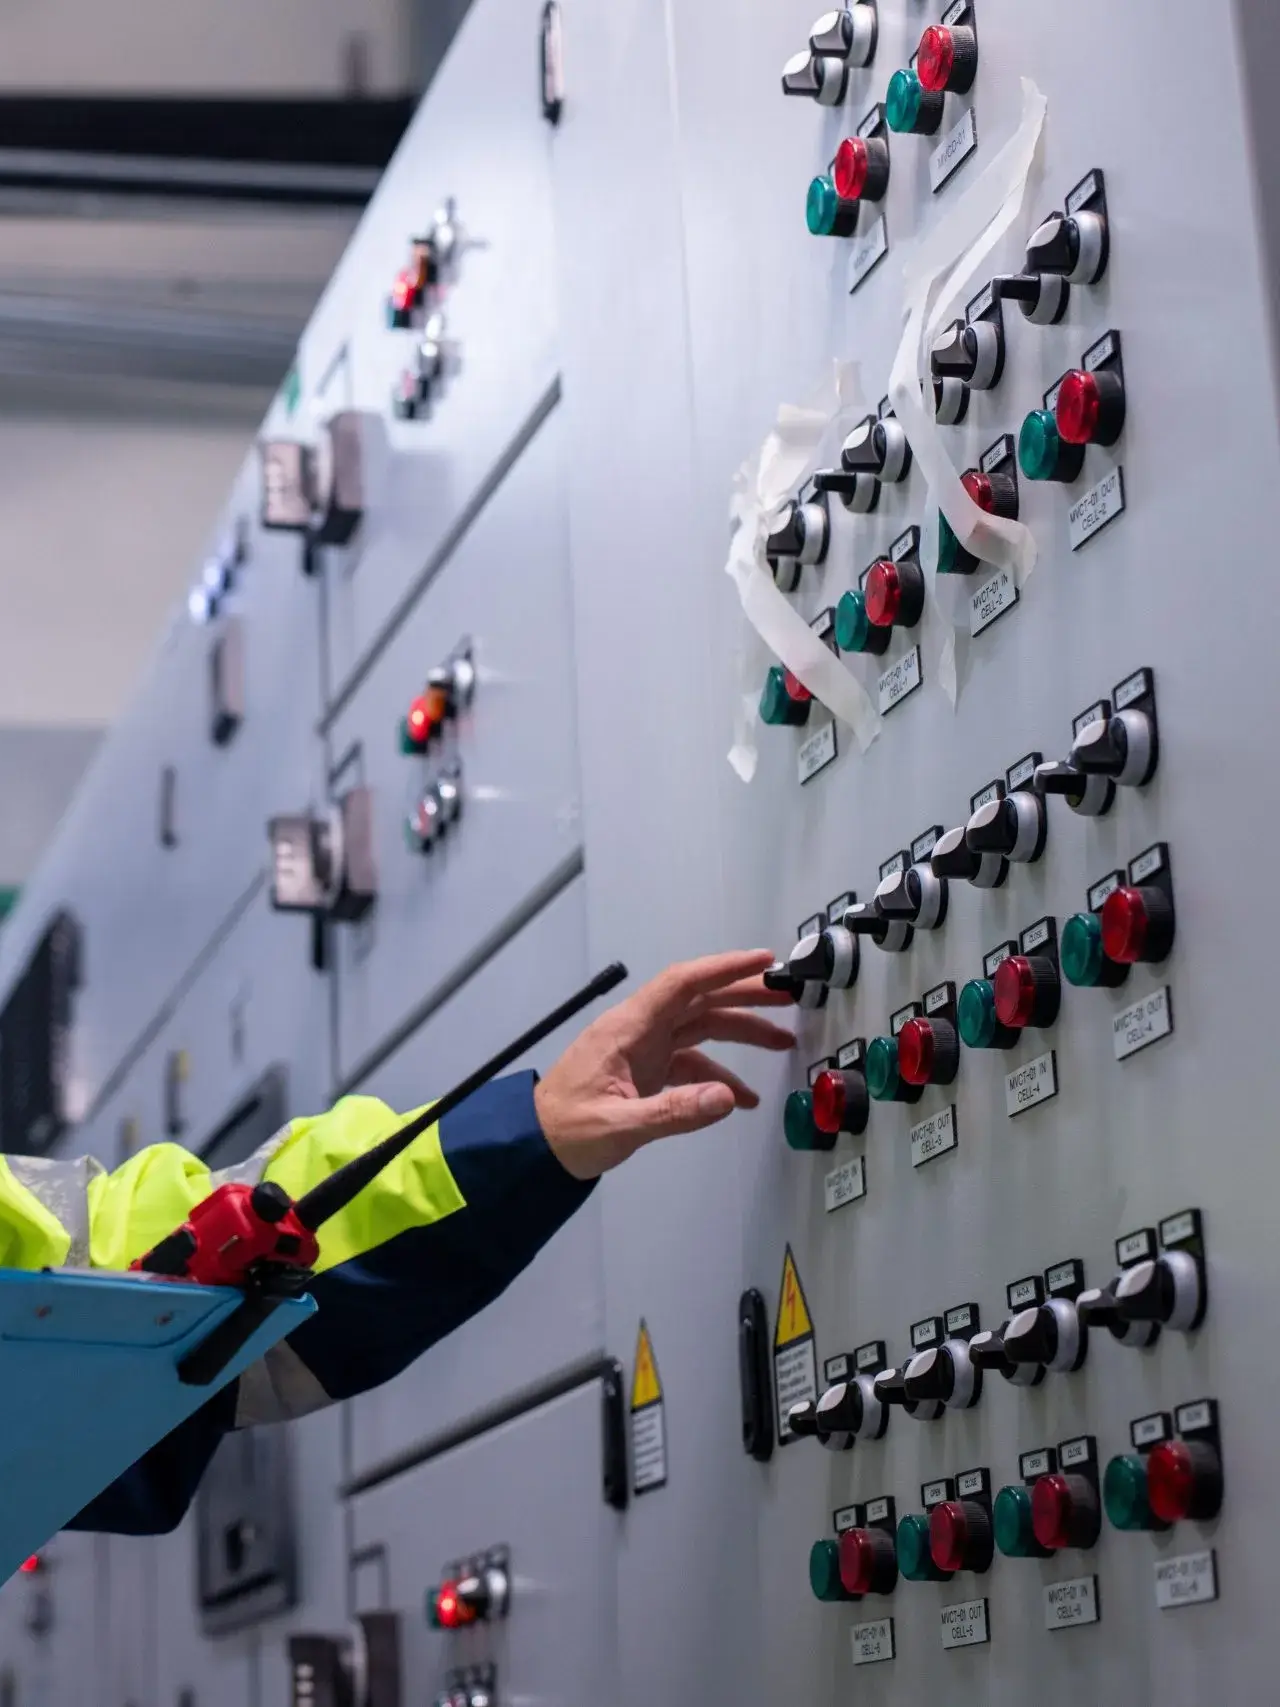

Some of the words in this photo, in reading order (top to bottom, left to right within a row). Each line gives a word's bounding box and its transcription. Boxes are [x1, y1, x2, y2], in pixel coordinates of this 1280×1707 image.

[1069, 491, 1098, 523] MVCT-01
[1101, 475, 1116, 497] OUT
[1082, 502, 1107, 530] CELL-2
[973, 579, 999, 611] MVCT-01
[1001, 573, 1009, 586] IN
[981, 593, 1004, 619] CELL-2
[879, 667, 902, 692] MVCT-01
[903, 653, 916, 676] OUT
[889, 676, 908, 699] CELL-1
[1028, 928, 1043, 943] CLOSE
[931, 991, 944, 1005] CLOSE
[1113, 1006, 1144, 1033] MVCT-01
[1147, 994, 1163, 1016] OUT
[1009, 1065, 1036, 1090] MVCT-01
[1039, 1060, 1047, 1075] IN
[1017, 1081, 1040, 1103] CELL-4
[911, 1120, 935, 1144] MVCT-01
[938, 1113, 950, 1129] OUT
[1067, 1446, 1082, 1459] CLOSE
[1029, 1459, 1041, 1469] OPEN
[929, 1487, 941, 1497] OPEN
[964, 1477, 978, 1489] CLOSE
[941, 1608, 966, 1624] MVCT-01
[969, 1605, 982, 1620] OUT
[951, 1624, 974, 1640] CELL-5
